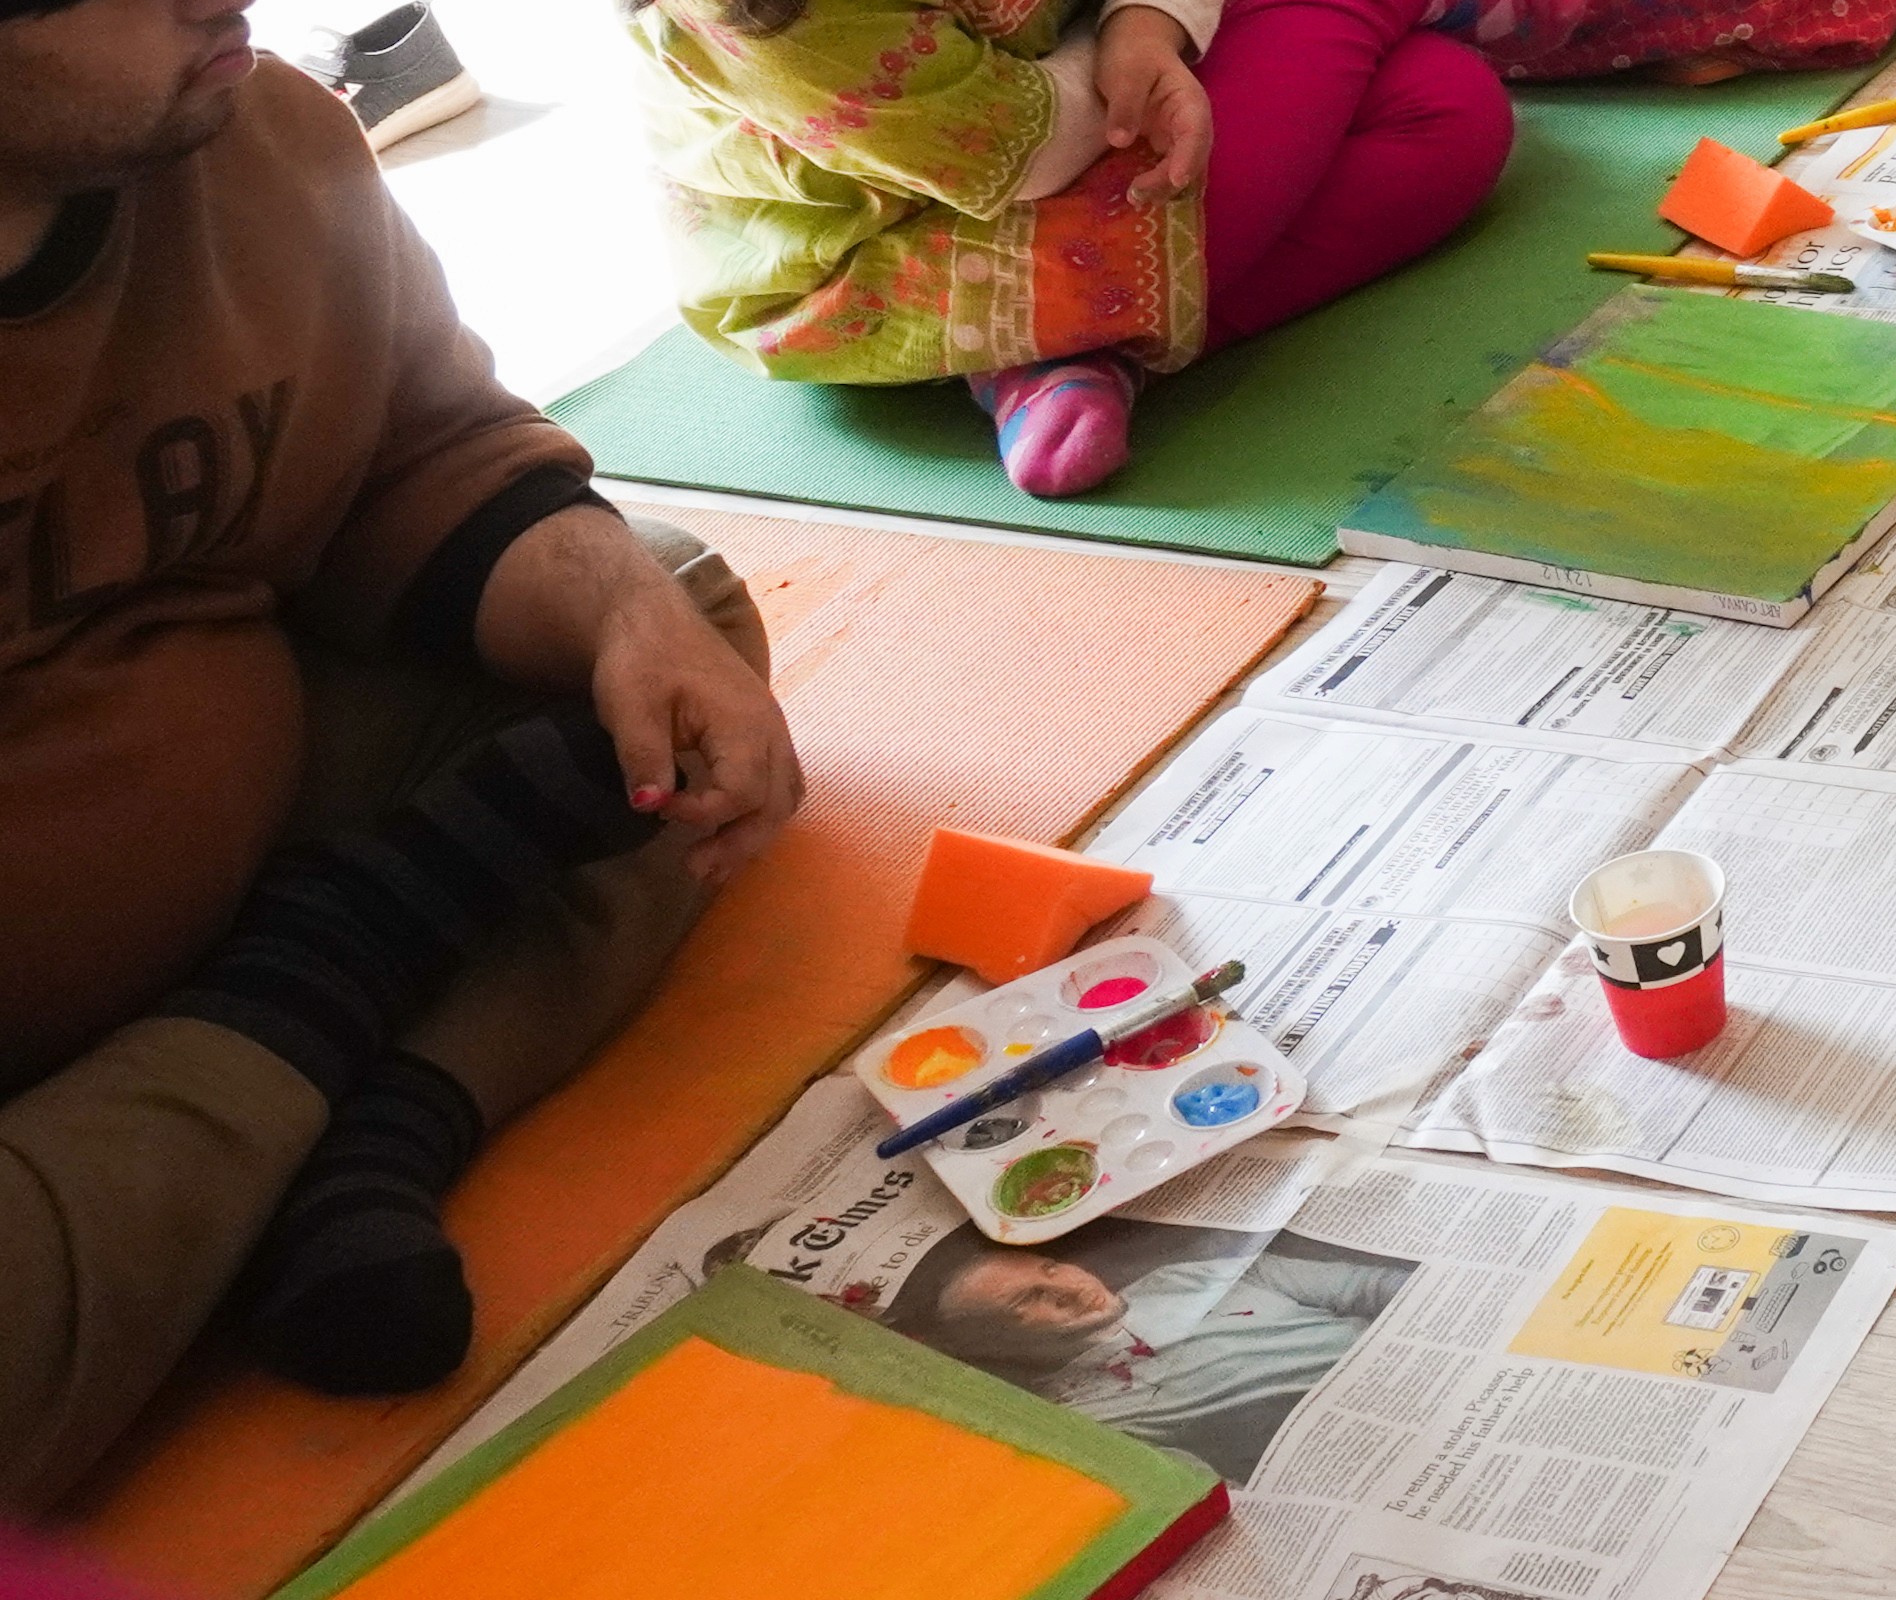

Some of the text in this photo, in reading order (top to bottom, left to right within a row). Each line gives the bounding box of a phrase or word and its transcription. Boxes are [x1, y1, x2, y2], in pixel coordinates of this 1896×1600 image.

[1761, 600, 1782, 618] ART
[1377, 780, 1483, 891] ENGINEER PUBLIC HEALTH
[1379, 765, 1484, 874] OFFICE OF THE EXECUTIVE
[1382, 748, 1524, 898] DIVISION TANDO MUHAMMAD KHAN
[1286, 988, 1344, 1036] INVITING
[1328, 941, 1384, 988] TENDERS
[789, 1169, 914, 1251] Times
[880, 1249, 908, 1272] to
[1383, 1367, 1514, 1513] To return a stolen Picasso,
[1406, 1368, 1535, 1520] he needed his father's help
